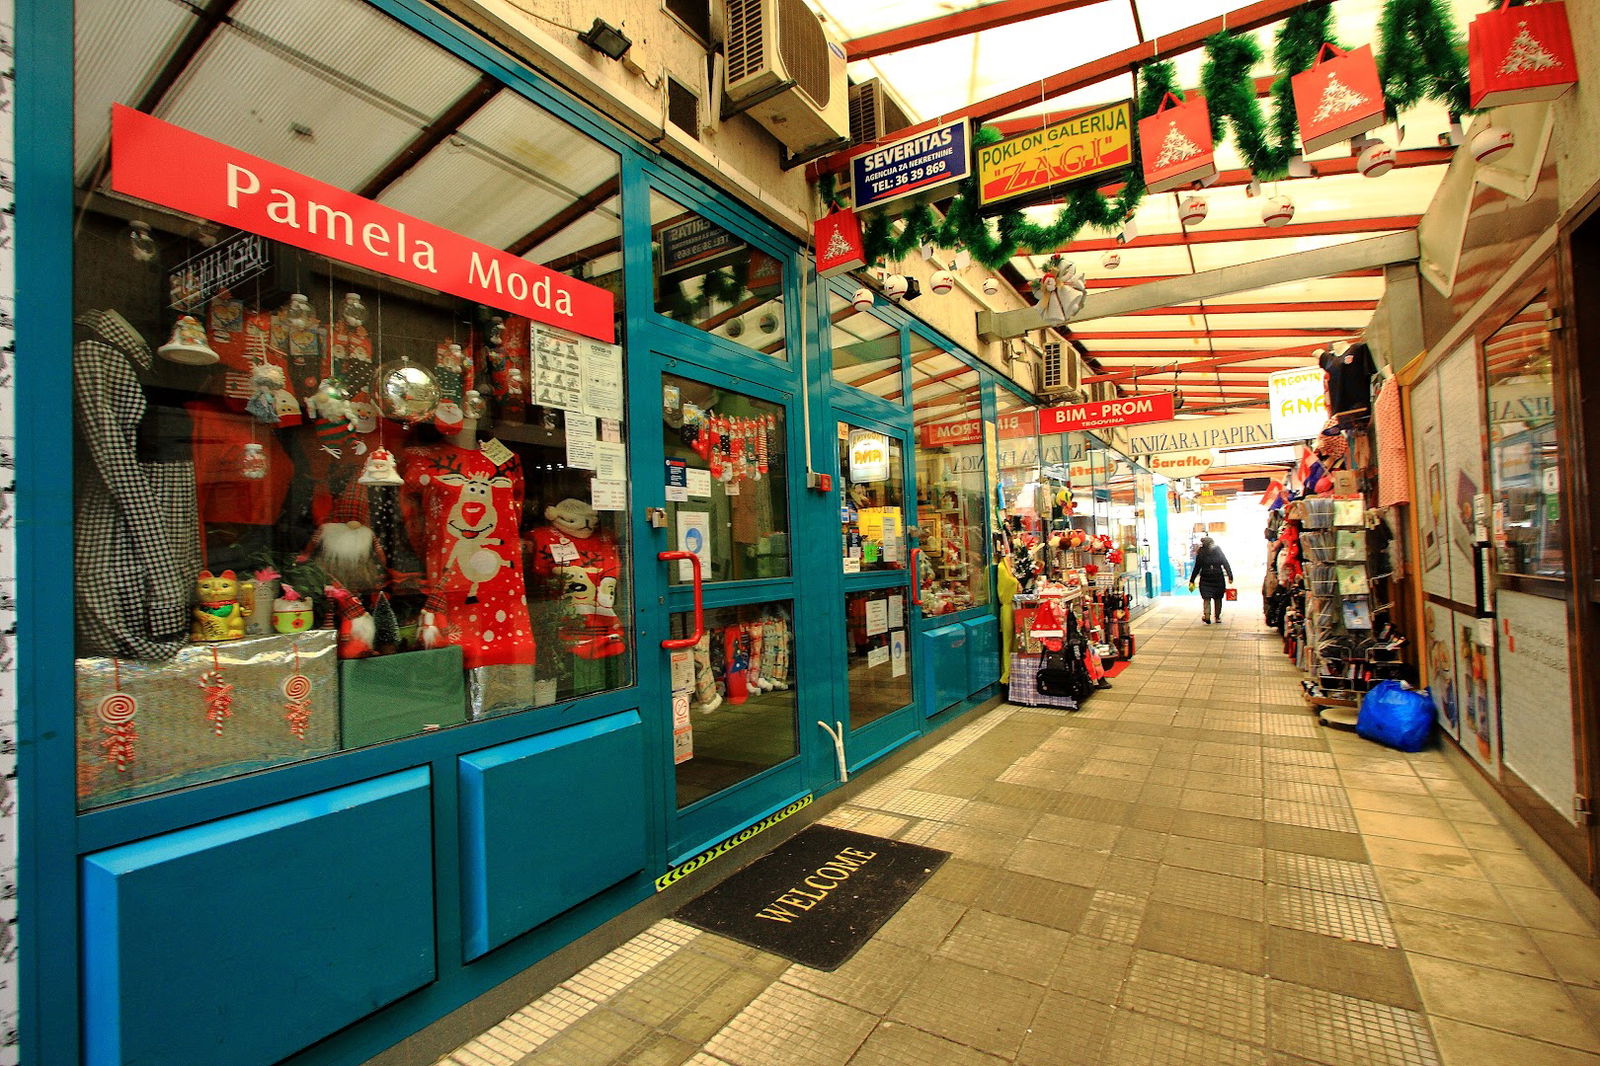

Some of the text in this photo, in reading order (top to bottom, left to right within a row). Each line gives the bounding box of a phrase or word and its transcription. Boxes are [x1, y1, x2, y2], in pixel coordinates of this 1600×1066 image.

[864, 127, 952, 172] SEVERITAS
[982, 108, 1128, 172] POKLON GALERIJA
[865, 147, 953, 183] AGENCIJA ZA NEKRETNINE
[872, 160, 946, 193] TEL: 36 39 869
[226, 162, 438, 273] Pamela
[467, 251, 574, 318] Moda
[1274, 373, 1321, 392] TRGOVIN
[1101, 399, 1153, 418] PROM
[1281, 394, 1326, 416] ANA
[1081, 417, 1125, 427] TRGOVINA
[1130, 423, 1274, 454] KNJIŽARA I PAPIRNI
[1152, 456, 1210, 469] Šarafko
[755, 847, 877, 924] WELCOME
